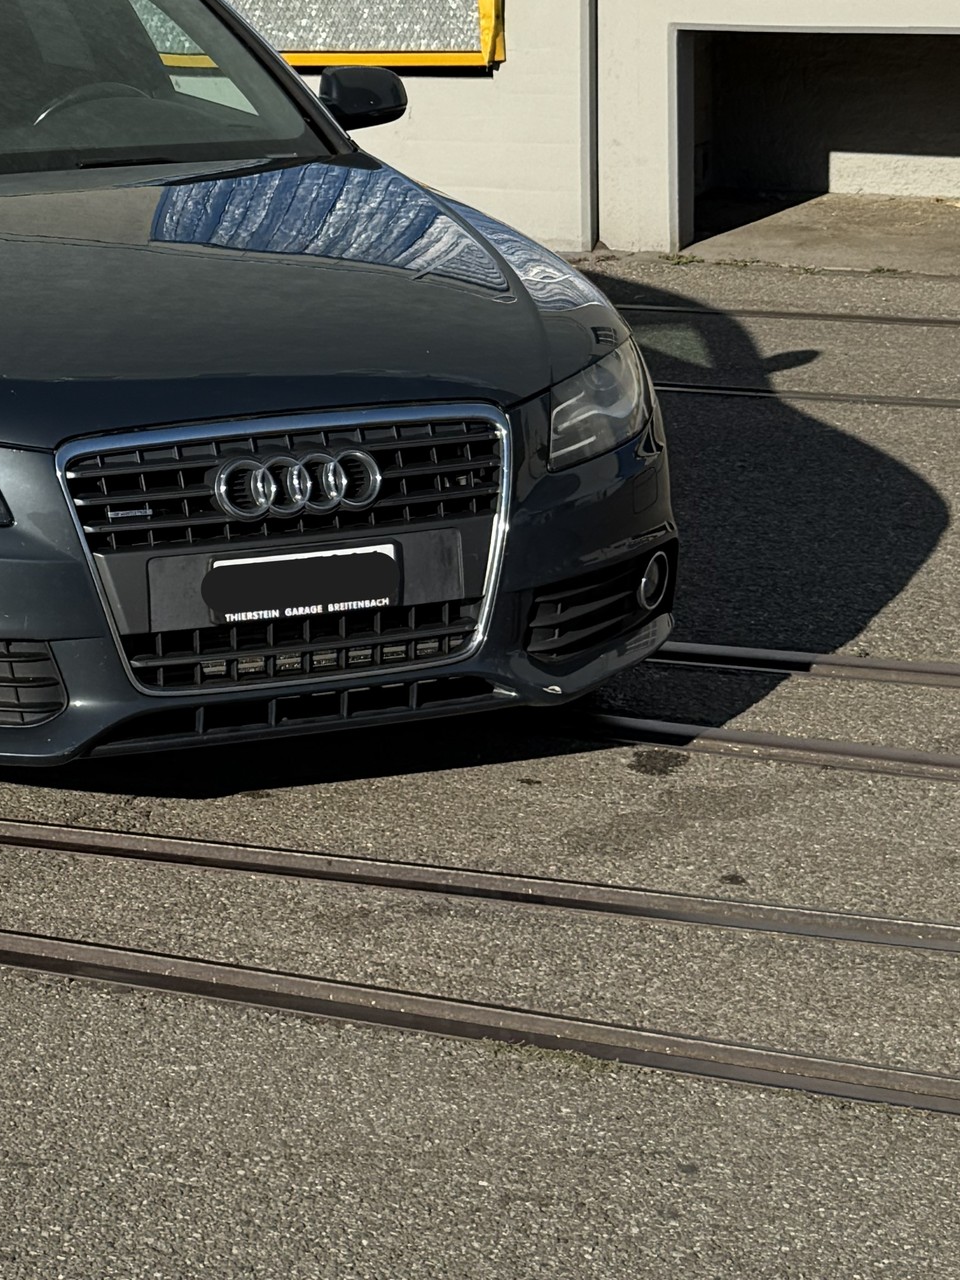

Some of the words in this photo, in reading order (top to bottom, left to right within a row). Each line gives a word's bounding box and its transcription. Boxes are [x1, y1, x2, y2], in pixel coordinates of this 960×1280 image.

[225, 609, 280, 623] THIERSTEIN
[284, 604, 323, 617] GARAGE
[327, 597, 390, 612] BREITENBACH
